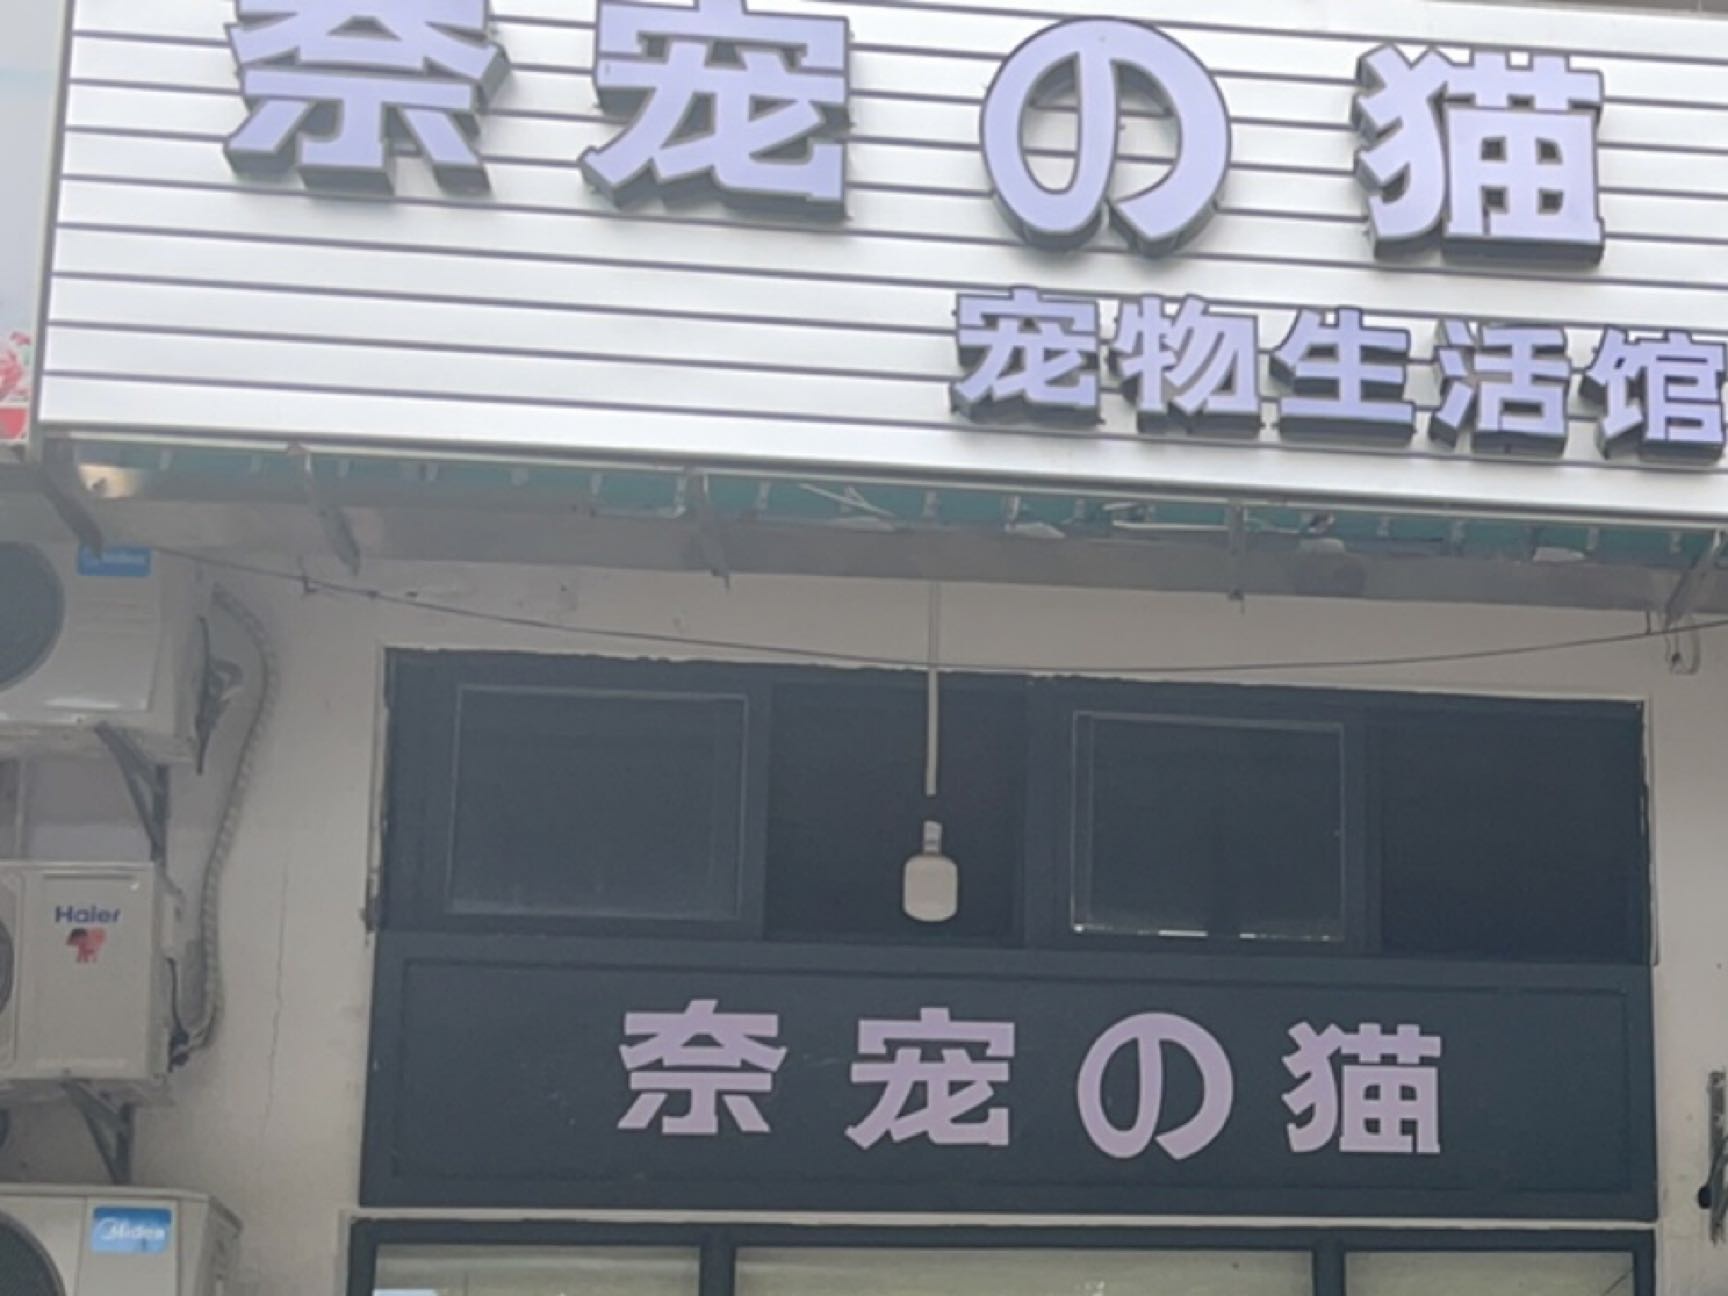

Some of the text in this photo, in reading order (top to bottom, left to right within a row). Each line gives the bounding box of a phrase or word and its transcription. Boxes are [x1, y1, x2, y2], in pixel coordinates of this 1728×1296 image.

[222, 0, 1604, 260] 奈宠の猫
[952, 288, 1728, 458] 宠物生活馆
[54, 904, 121, 926] Haier
[618, 1000, 1442, 1160] 奈宠の猫
